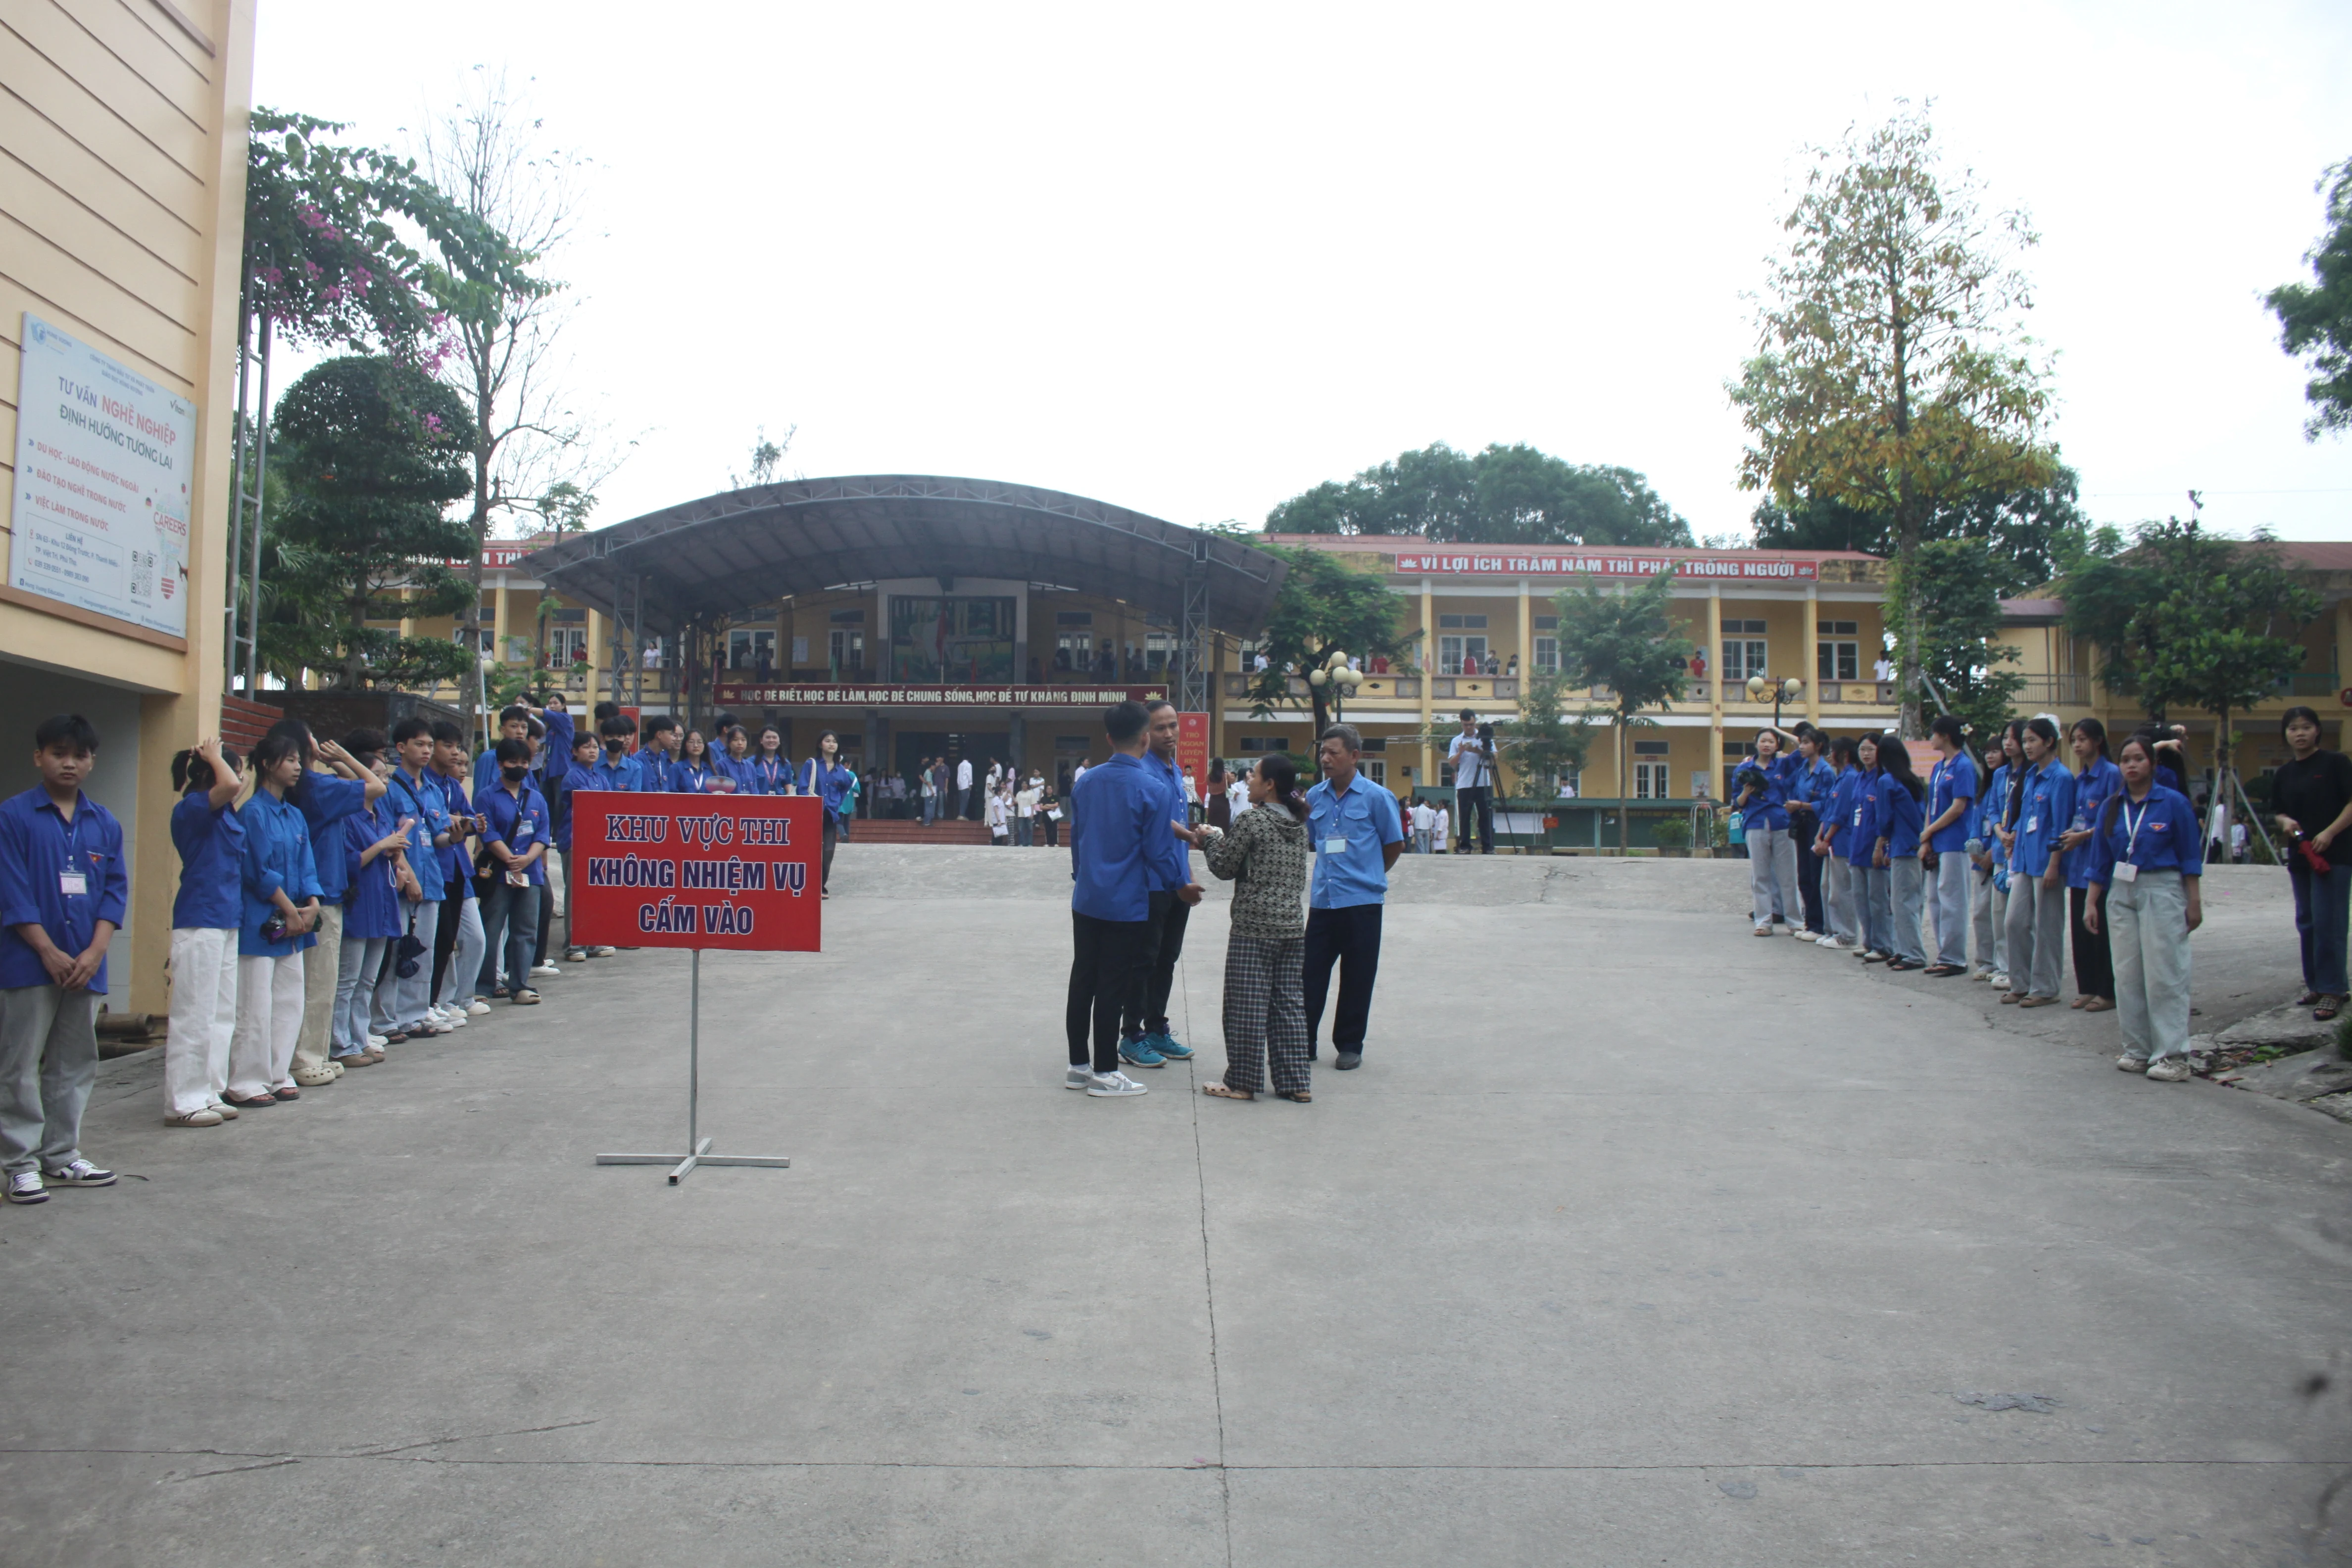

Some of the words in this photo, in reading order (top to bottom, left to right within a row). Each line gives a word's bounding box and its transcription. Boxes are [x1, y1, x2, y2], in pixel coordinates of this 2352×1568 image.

[59, 376, 74, 395] TƯ
[102, 395, 134, 426] NGHỀ
[137, 413, 176, 448] NGHIỆP
[60, 404, 86, 429] ĐỊNH
[88, 418, 124, 446] HƯỚNG
[126, 436, 157, 463] TƯƠNG
[159, 452, 172, 470] LAI
[37, 441, 47, 453] DU
[49, 446, 62, 461] HỌC
[67, 455, 80, 467] LAO
[82, 461, 99, 476] ĐỘNG
[101, 469, 119, 485] NƯỚC
[120, 478, 139, 493] NGOÀI
[37, 468, 51, 482] ĐÀO
[53, 475, 66, 489] TẠO
[67, 482, 85, 496] NGHỀ
[86, 489, 107, 505] TRONG
[108, 498, 126, 513] NƯỚC
[35, 495, 50, 510] VIỆC
[51, 500, 65, 515] LÀM
[67, 508, 89, 524] TRONG
[90, 517, 108, 531] NƯỚC
[154, 512, 186, 536] CAREERS
[1421, 554, 1437, 570] VÌ
[1442, 556, 1469, 574] LỢI
[1473, 554, 1502, 571] ÍCH
[1507, 555, 1557, 572] TRĂM
[1562, 556, 1602, 573] NĂM
[1607, 557, 1633, 573] THÌ
[1744, 559, 1795, 577] NGƯỜI
[740, 690, 761, 705] HỌC
[803, 690, 824, 705] HỌC
[842, 687, 867, 703] LÀM,
[868, 690, 889, 705] HỌC
[906, 690, 941, 702] CHUNG
[976, 690, 996, 705] HỌC
[1015, 690, 1029, 705] TỰ
[1071, 691, 1096, 705] ĐỊNH
[1098, 688, 1127, 703] MÌNH
[605, 814, 669, 843] KHU
[676, 813, 733, 851] VỰC
[739, 818, 790, 845] THI
[588, 853, 675, 888] KHÔNG
[682, 855, 765, 895] NHIỆM
[773, 862, 806, 897] VỤ
[638, 895, 696, 933] CẤM
[703, 900, 753, 934] VÀO
